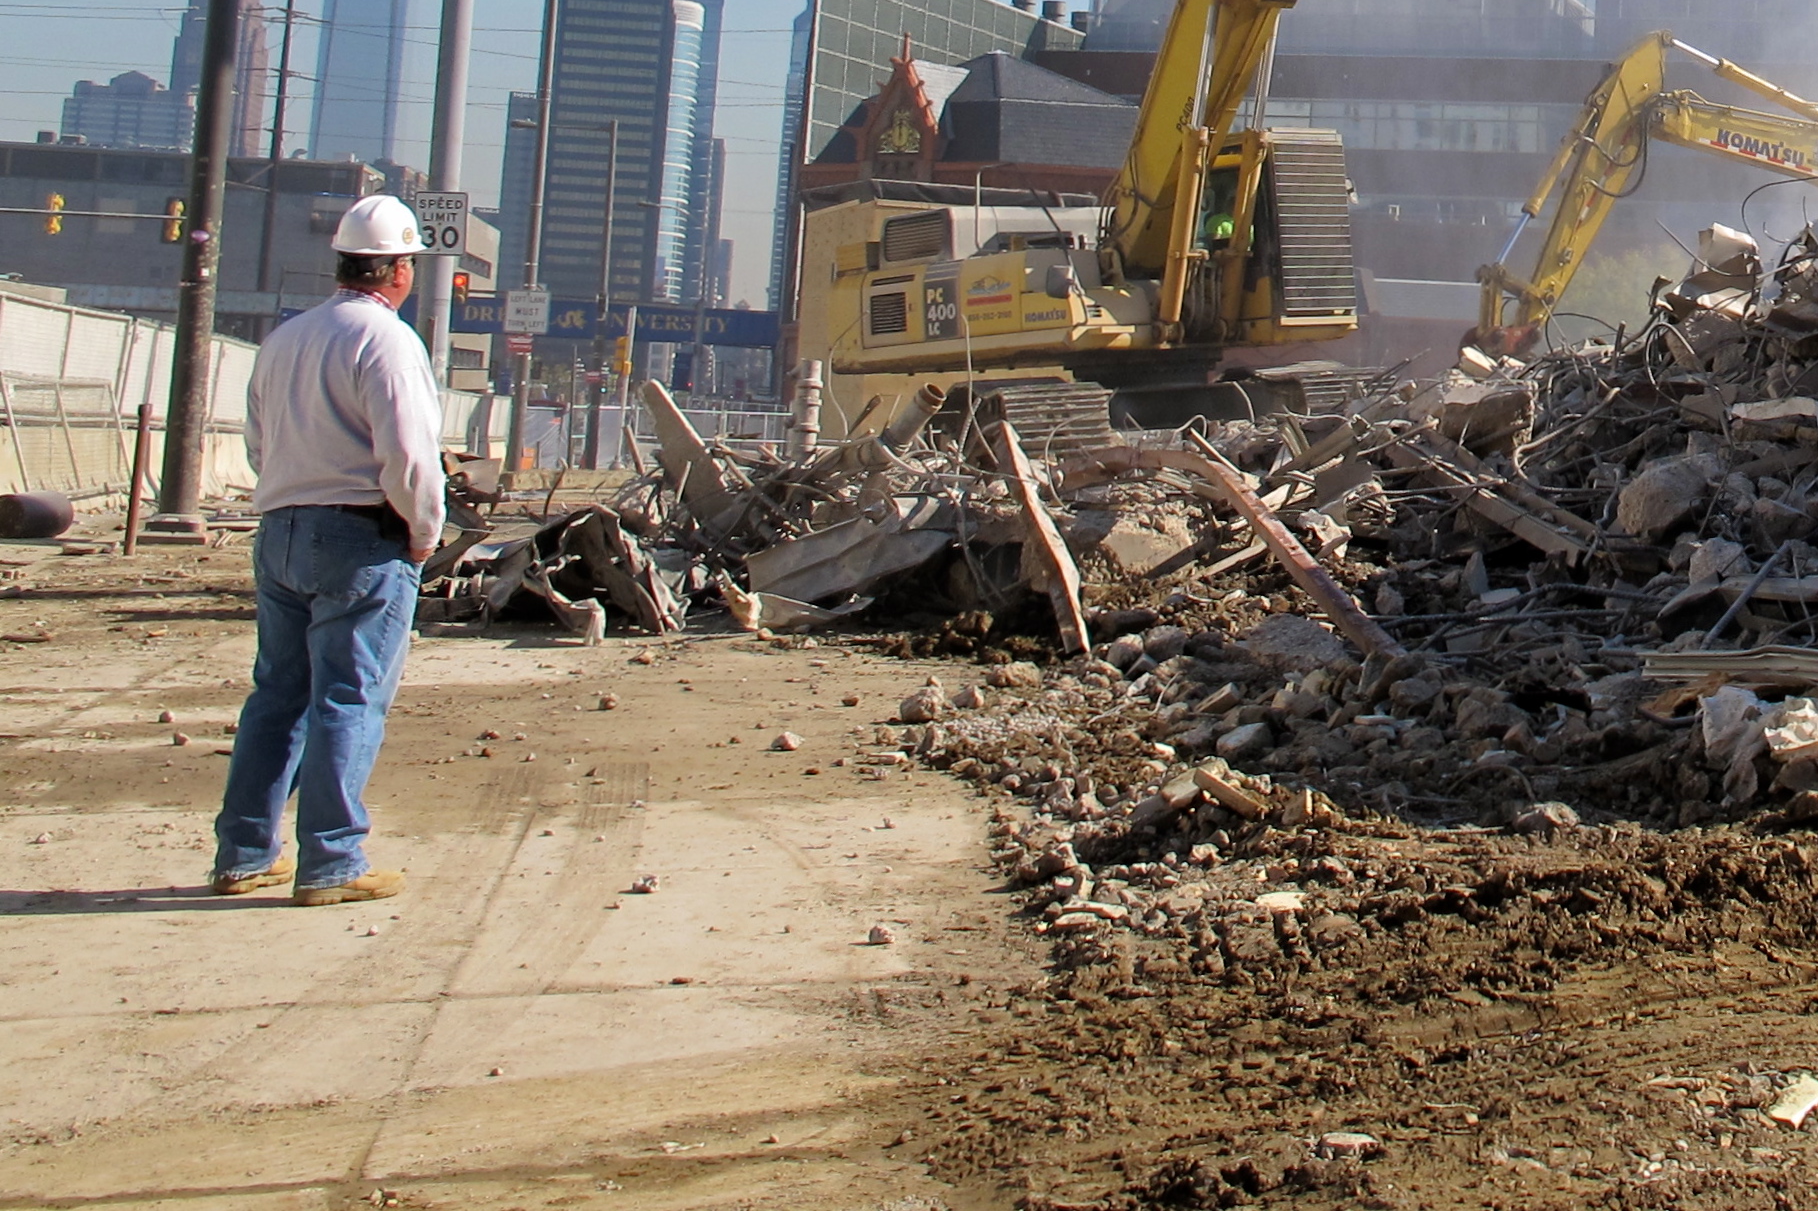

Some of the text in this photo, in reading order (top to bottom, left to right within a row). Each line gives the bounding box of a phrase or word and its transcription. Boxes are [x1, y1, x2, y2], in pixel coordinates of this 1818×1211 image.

[1716, 128, 1804, 166] KOMATSU
[418, 198, 463, 210] SPEED
[422, 212, 458, 222] LIMIT
[421, 225, 459, 248] 30
[926, 287, 944, 304] PC
[516, 307, 540, 316] MUST
[927, 303, 957, 322] 400
[1024, 308, 1066, 323] KOMATSU
[928, 322, 941, 336] LC
